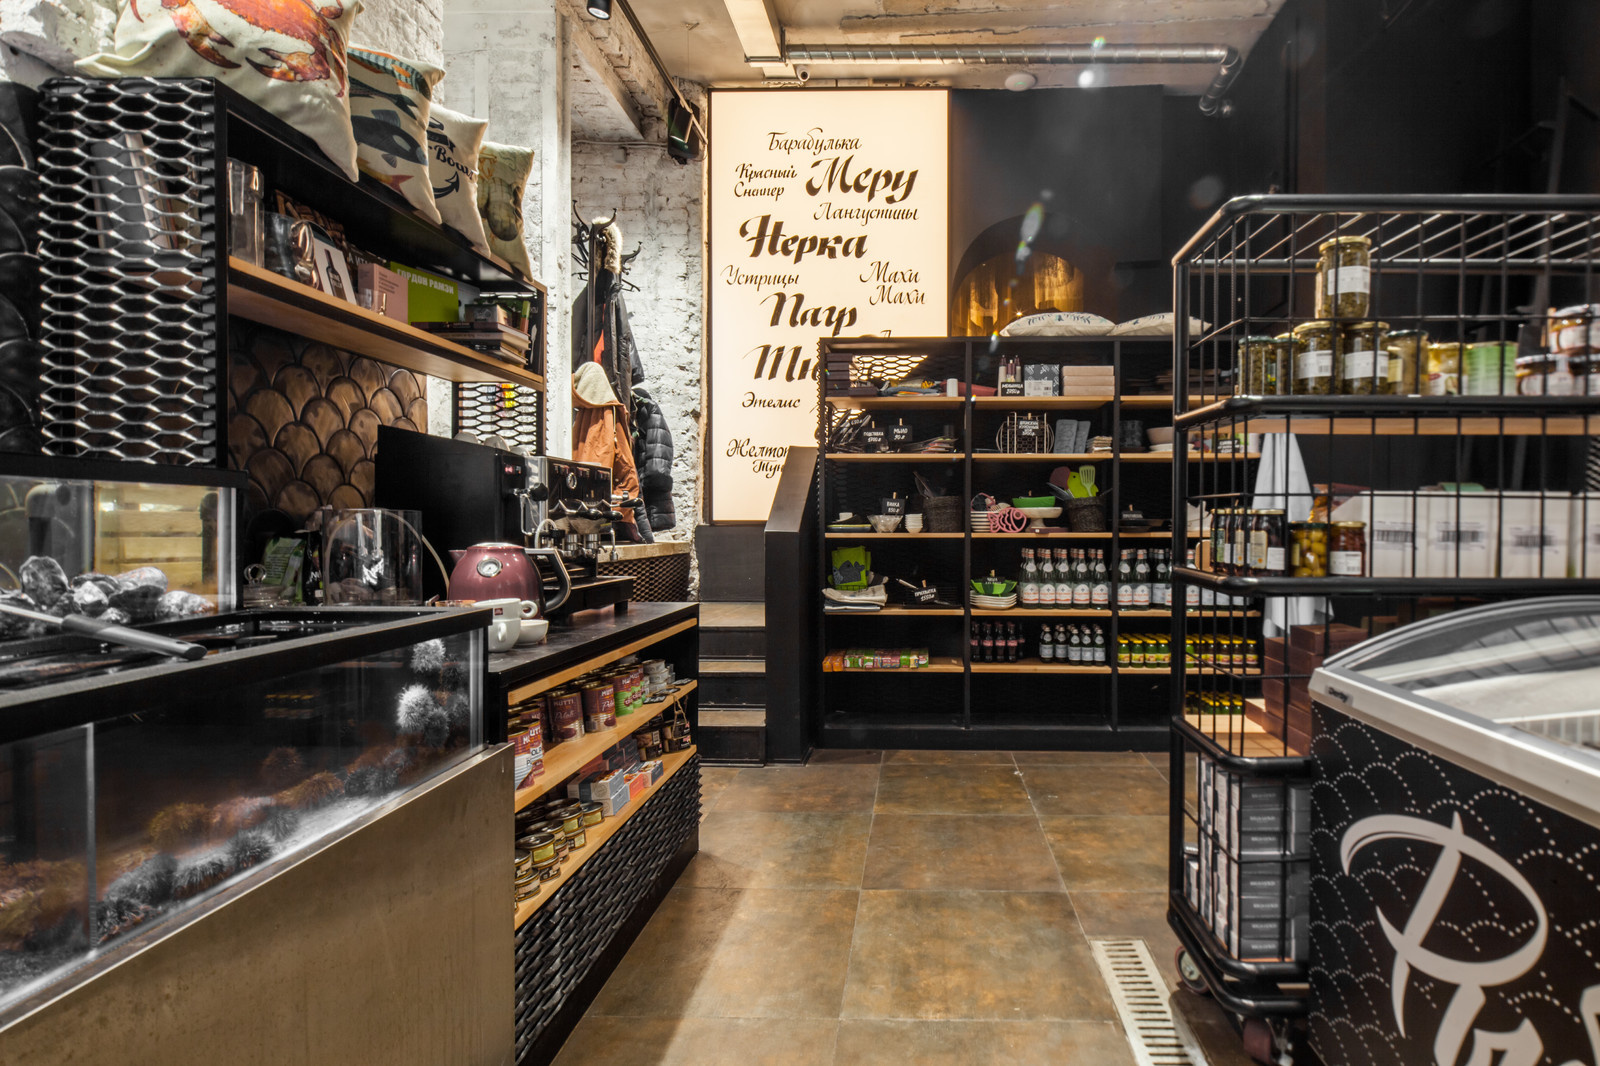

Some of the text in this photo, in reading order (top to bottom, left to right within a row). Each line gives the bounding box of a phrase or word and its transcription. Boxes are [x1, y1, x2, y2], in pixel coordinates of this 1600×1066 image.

[767, 127, 862, 155] Барабулька
[735, 163, 798, 183] Красный
[805, 154, 919, 204] Меру
[734, 181, 785, 201] Снаппер
[813, 202, 919, 226] Лангустины
[739, 214, 868, 265] Нерка
[720, 264, 800, 291] Устрицы
[859, 261, 920, 283] Махи
[869, 285, 925, 306] Махи
[759, 292, 857, 337] Пагр
[741, 391, 801, 408] Этелис
